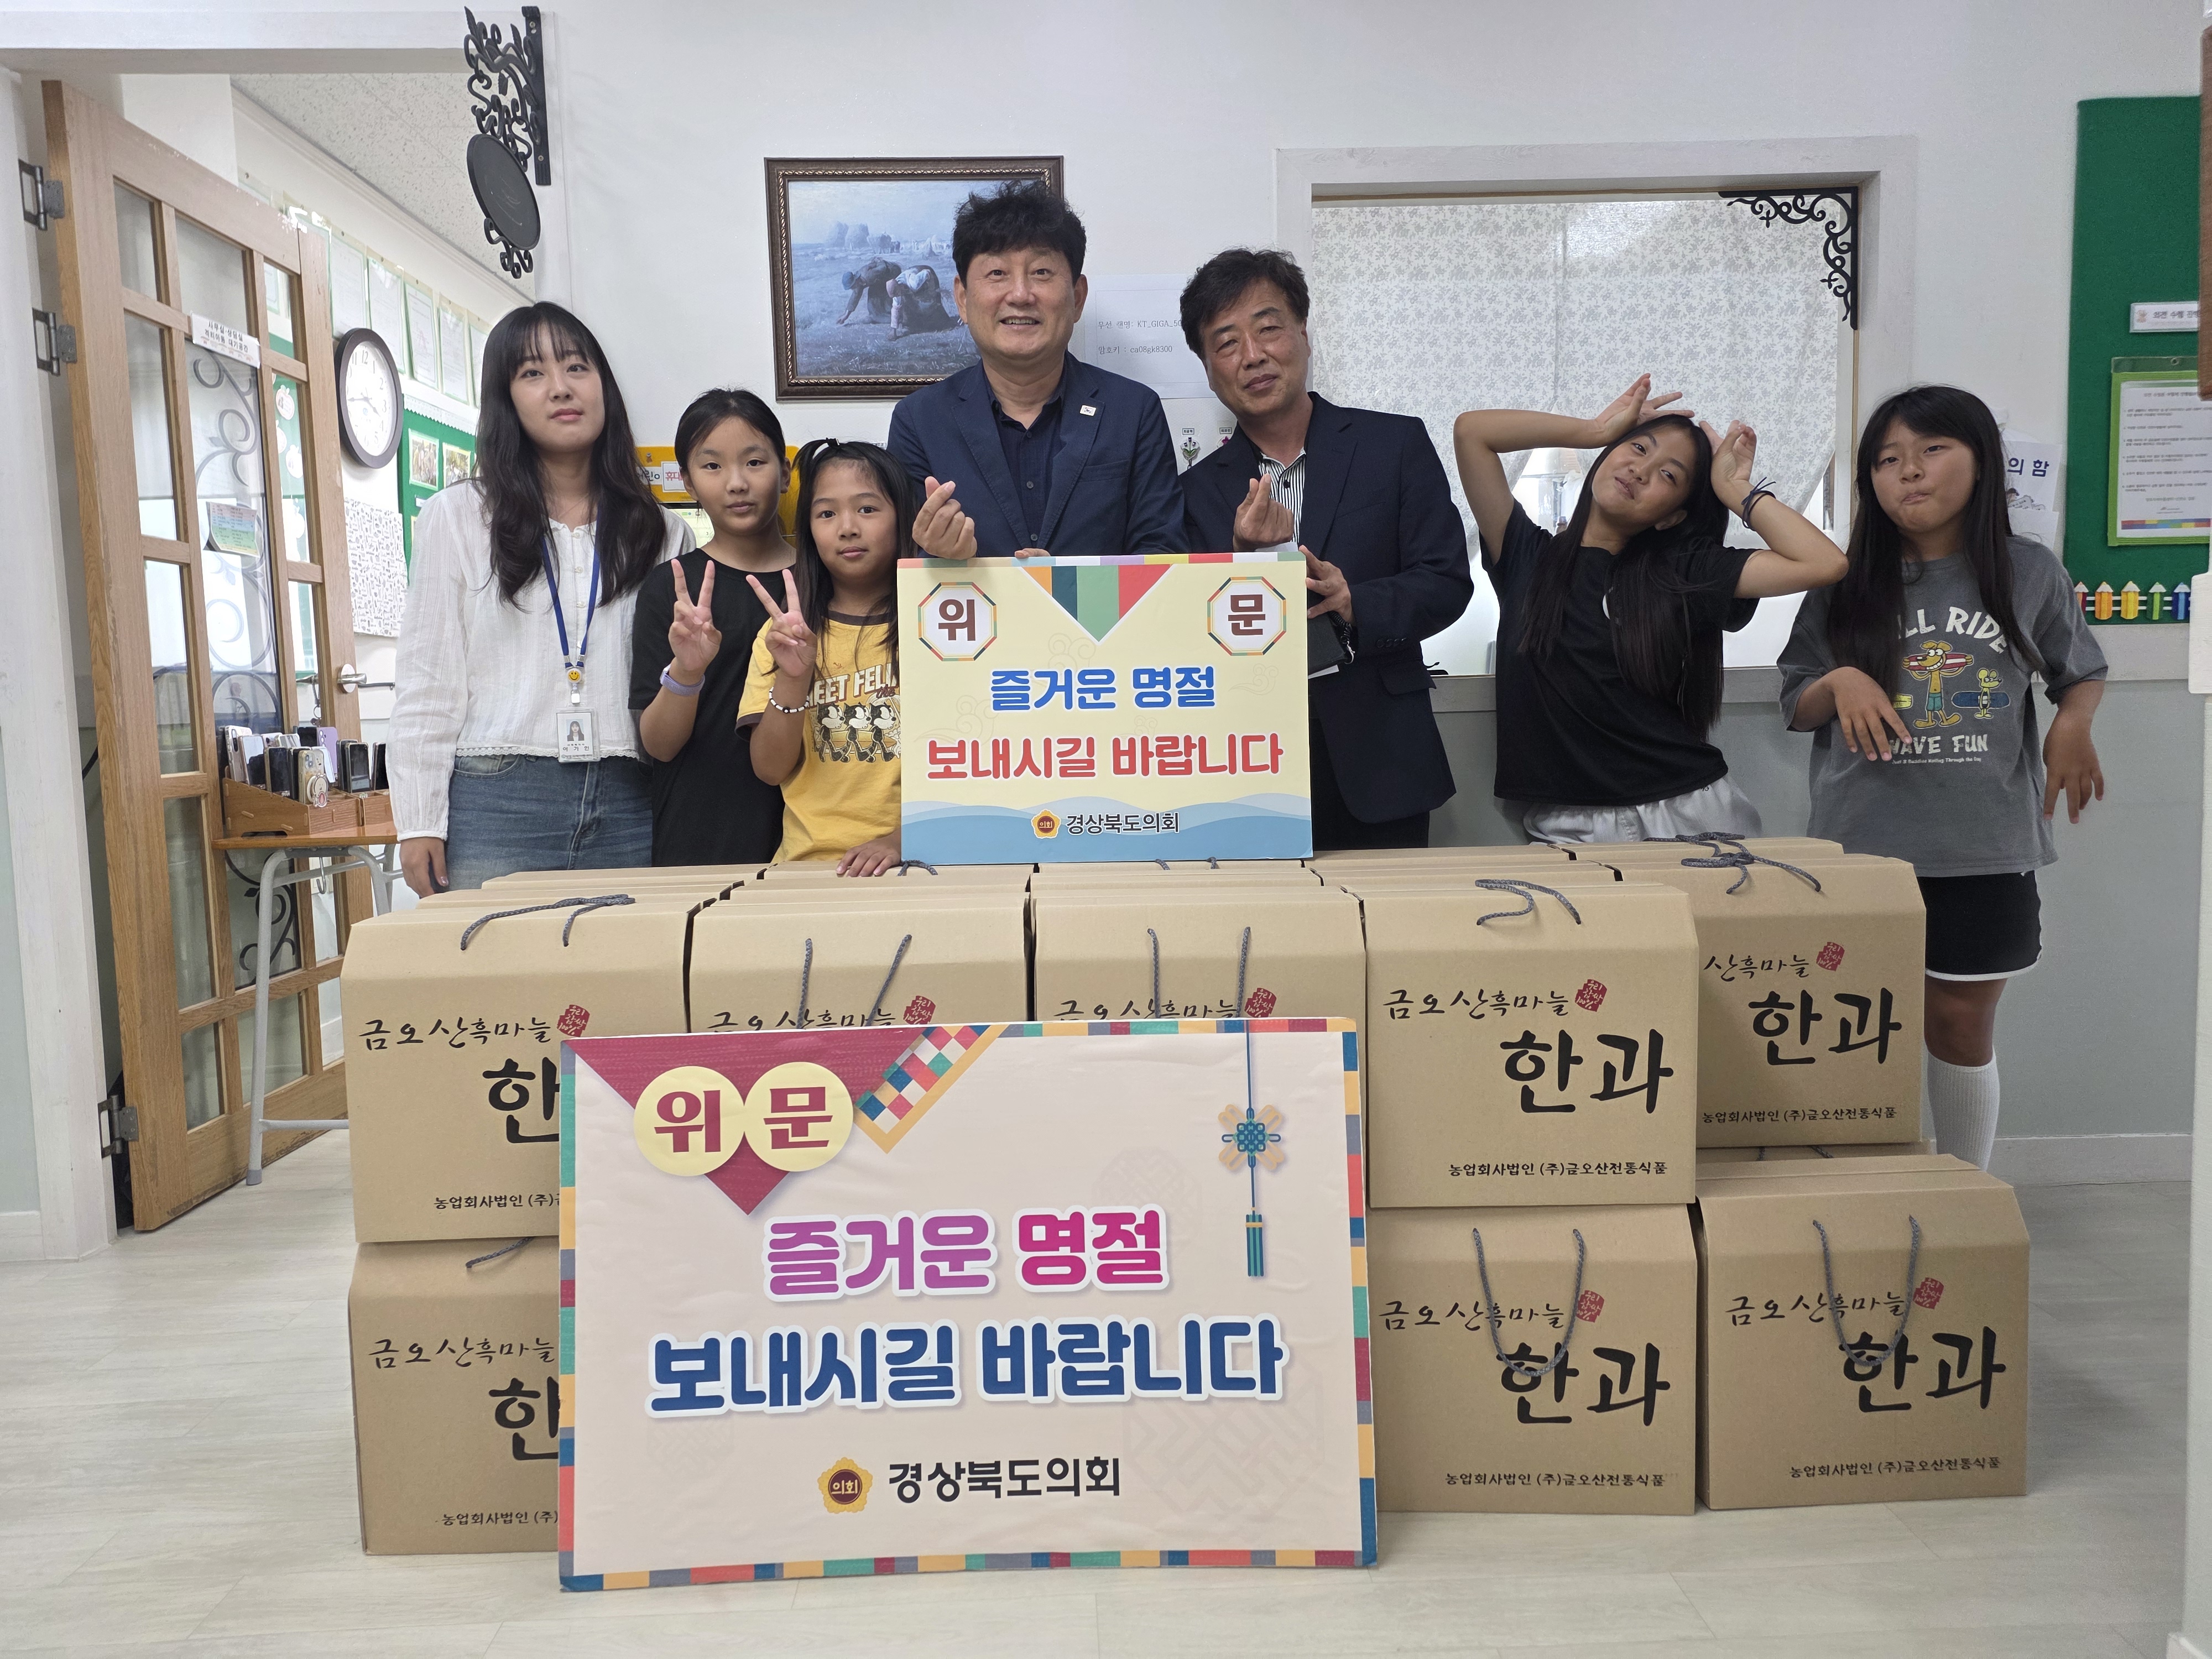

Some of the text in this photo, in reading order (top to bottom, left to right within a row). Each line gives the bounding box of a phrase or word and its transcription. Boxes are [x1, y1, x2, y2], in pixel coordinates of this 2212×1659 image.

[1097, 321, 1113, 329] 무선
[1116, 320, 1134, 329] 랜명:
[362, 349, 369, 365] 12
[1098, 345, 1120, 354] 암호키
[1130, 346, 1172, 354] ca08gk8300
[938, 594, 1266, 641] 위 문
[875, 684, 896, 699] the
[992, 666, 1215, 711] 즐거운 명절
[1952, 734, 1989, 753] FUN
[928, 733, 1283, 779] 보내시길 바랍니다
[1039, 812, 1179, 834] 의회 경상북도의회
[1246, 1005, 1263, 1018] 100%
[1576, 996, 1594, 1009] 100%
[559, 1022, 577, 1035] 100%
[904, 1013, 922, 1025] 100%
[1748, 987, 1902, 1066] 한과
[1500, 1029, 1674, 1114] 한과
[482, 1056, 560, 1144] 한
[653, 1086, 833, 1153] 위 문
[1702, 1107, 1898, 1125] 농업회사법인 (주)금오산전통식품
[1448, 1161, 1668, 1177] 농업회사법인 (주)금오산전통식품
[434, 1194, 523, 1209] 농업회사법인
[767, 1209, 1165, 1295] 즐거운 명절
[1577, 1310, 1592, 1320] 00%
[651, 1319, 1284, 1411] 보내시길 바랍니다
[1839, 1326, 2007, 1413] 한과
[1496, 1342, 1671, 1426] 한과
[488, 1376, 559, 1460] 한
[1790, 1457, 2001, 1479] 농업회사법인 (주)금오산전통식품
[831, 1456, 1120, 1504] 의회 경상북도의회
[1445, 1472, 1666, 1488] 농업회사법인 (주)금오산전통식품
[442, 1510, 559, 1526] 농업회사법인 (주)
